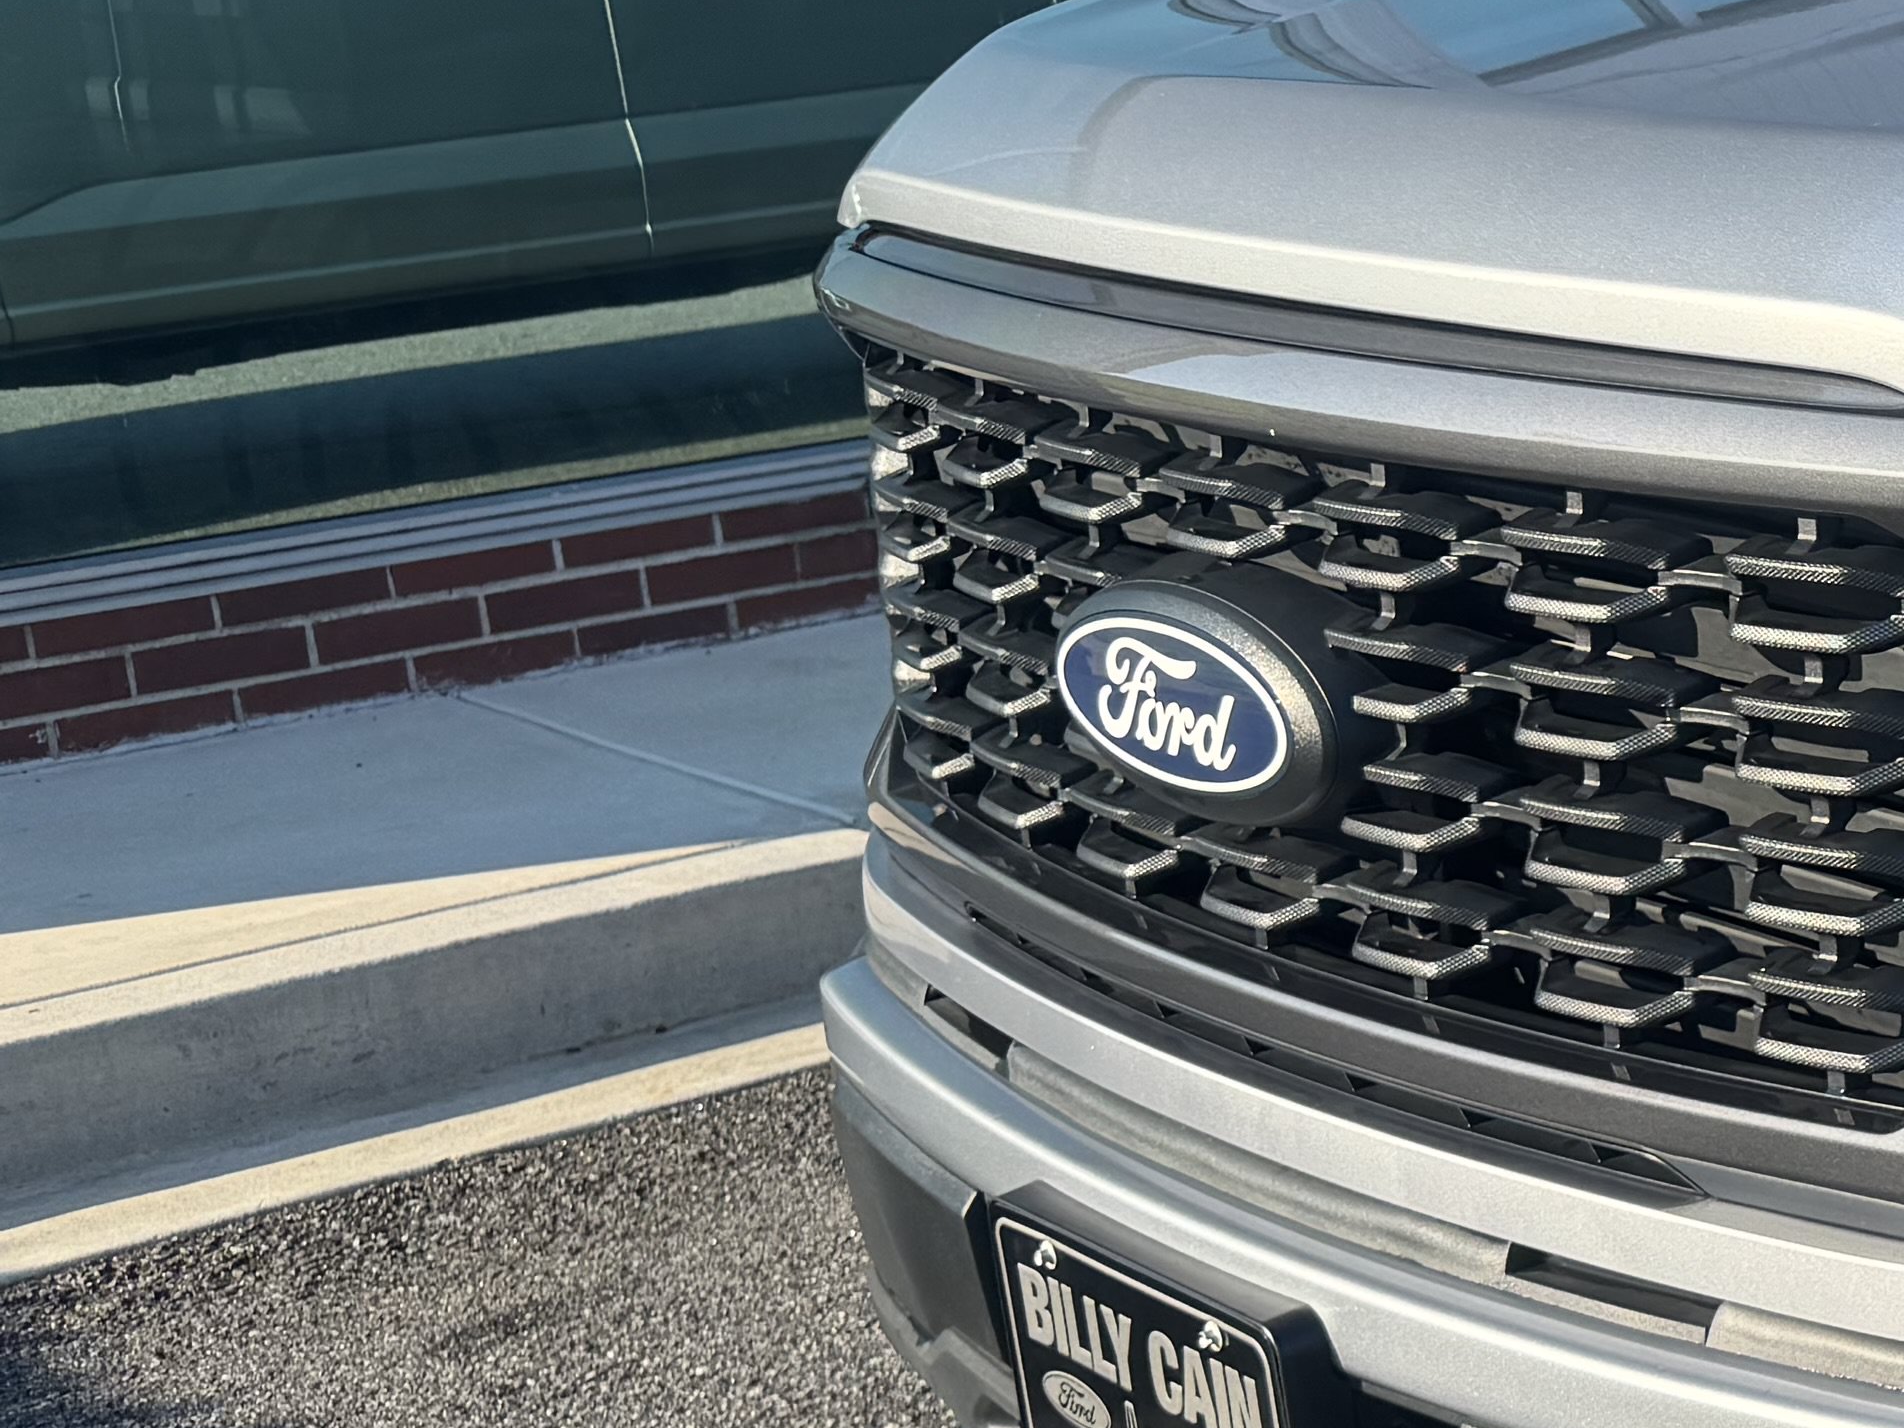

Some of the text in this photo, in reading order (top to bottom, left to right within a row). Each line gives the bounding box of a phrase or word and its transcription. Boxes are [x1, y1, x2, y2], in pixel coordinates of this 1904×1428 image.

[1098, 636, 1236, 771] Ford
[1016, 1262, 1133, 1393] BILLY
[1056, 1380, 1098, 1428] Ford
